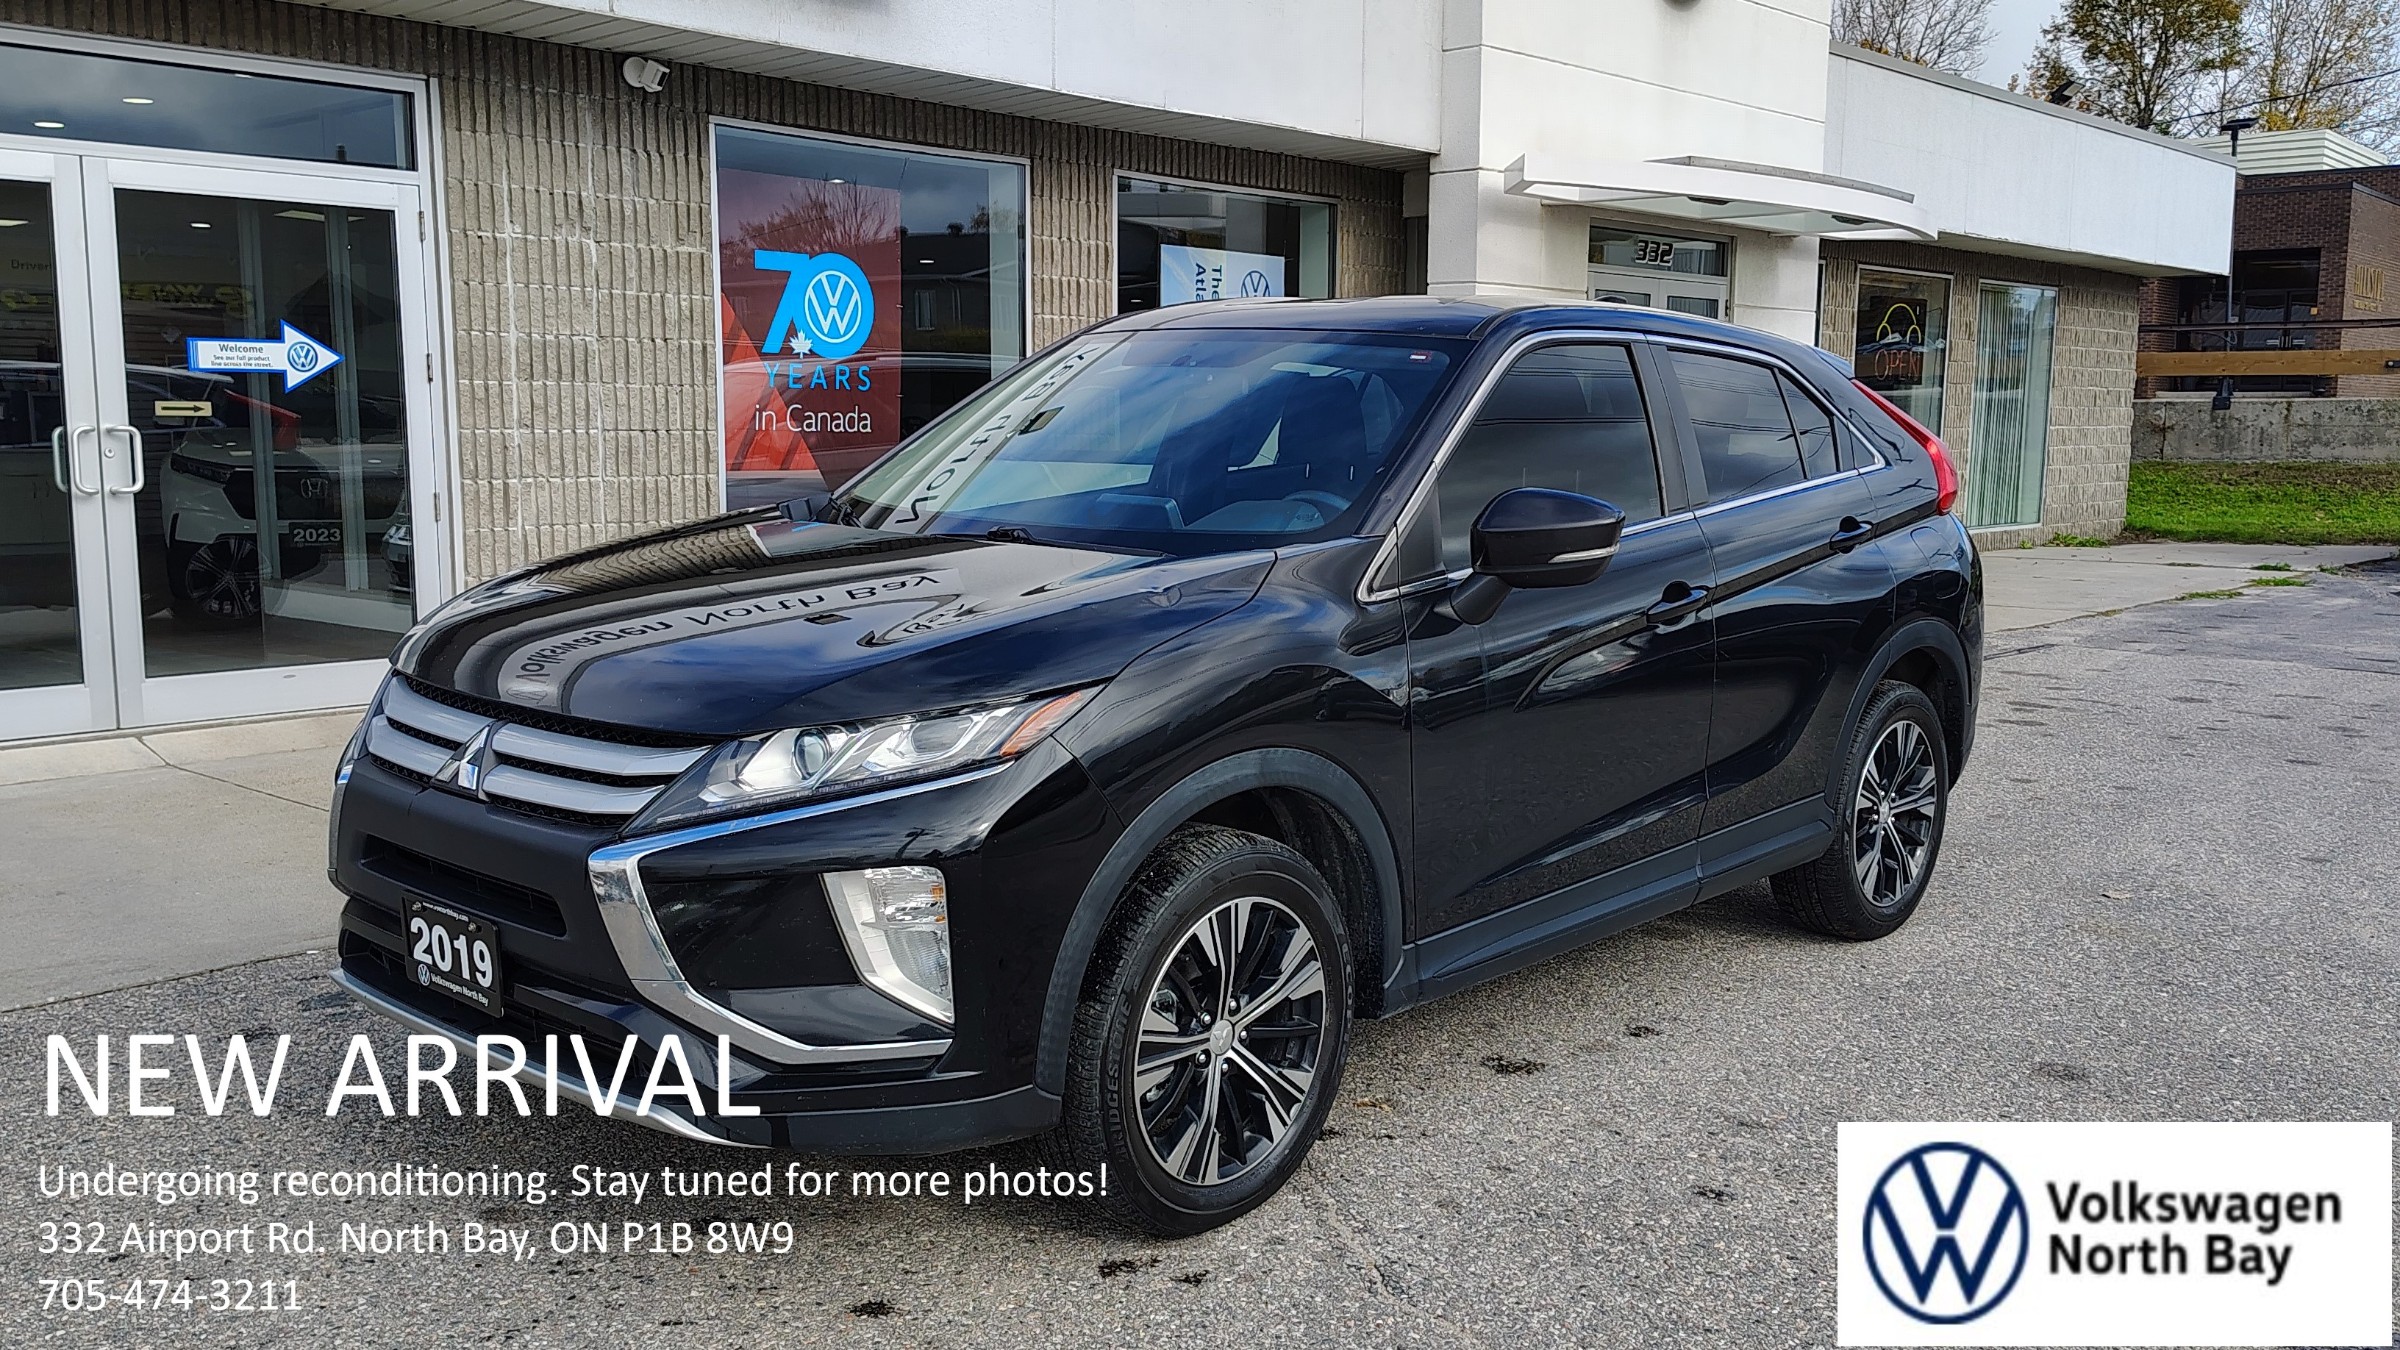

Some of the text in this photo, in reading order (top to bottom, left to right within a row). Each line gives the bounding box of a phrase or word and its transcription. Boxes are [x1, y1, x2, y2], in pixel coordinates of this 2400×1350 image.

[1633, 239, 1674, 266] 332
[1211, 264, 1223, 300] The
[754, 249, 876, 360] 70
[218, 343, 264, 354] Welcome
[247, 355, 270, 363] product
[243, 360, 253, 368] the
[764, 362, 872, 392] YEARS
[1875, 349, 1920, 380] OPEN
[755, 404, 873, 433] in Canada
[293, 528, 341, 543] 2023
[411, 917, 493, 988] 2019
[431, 972, 489, 1007] Volkswagen North Bay
